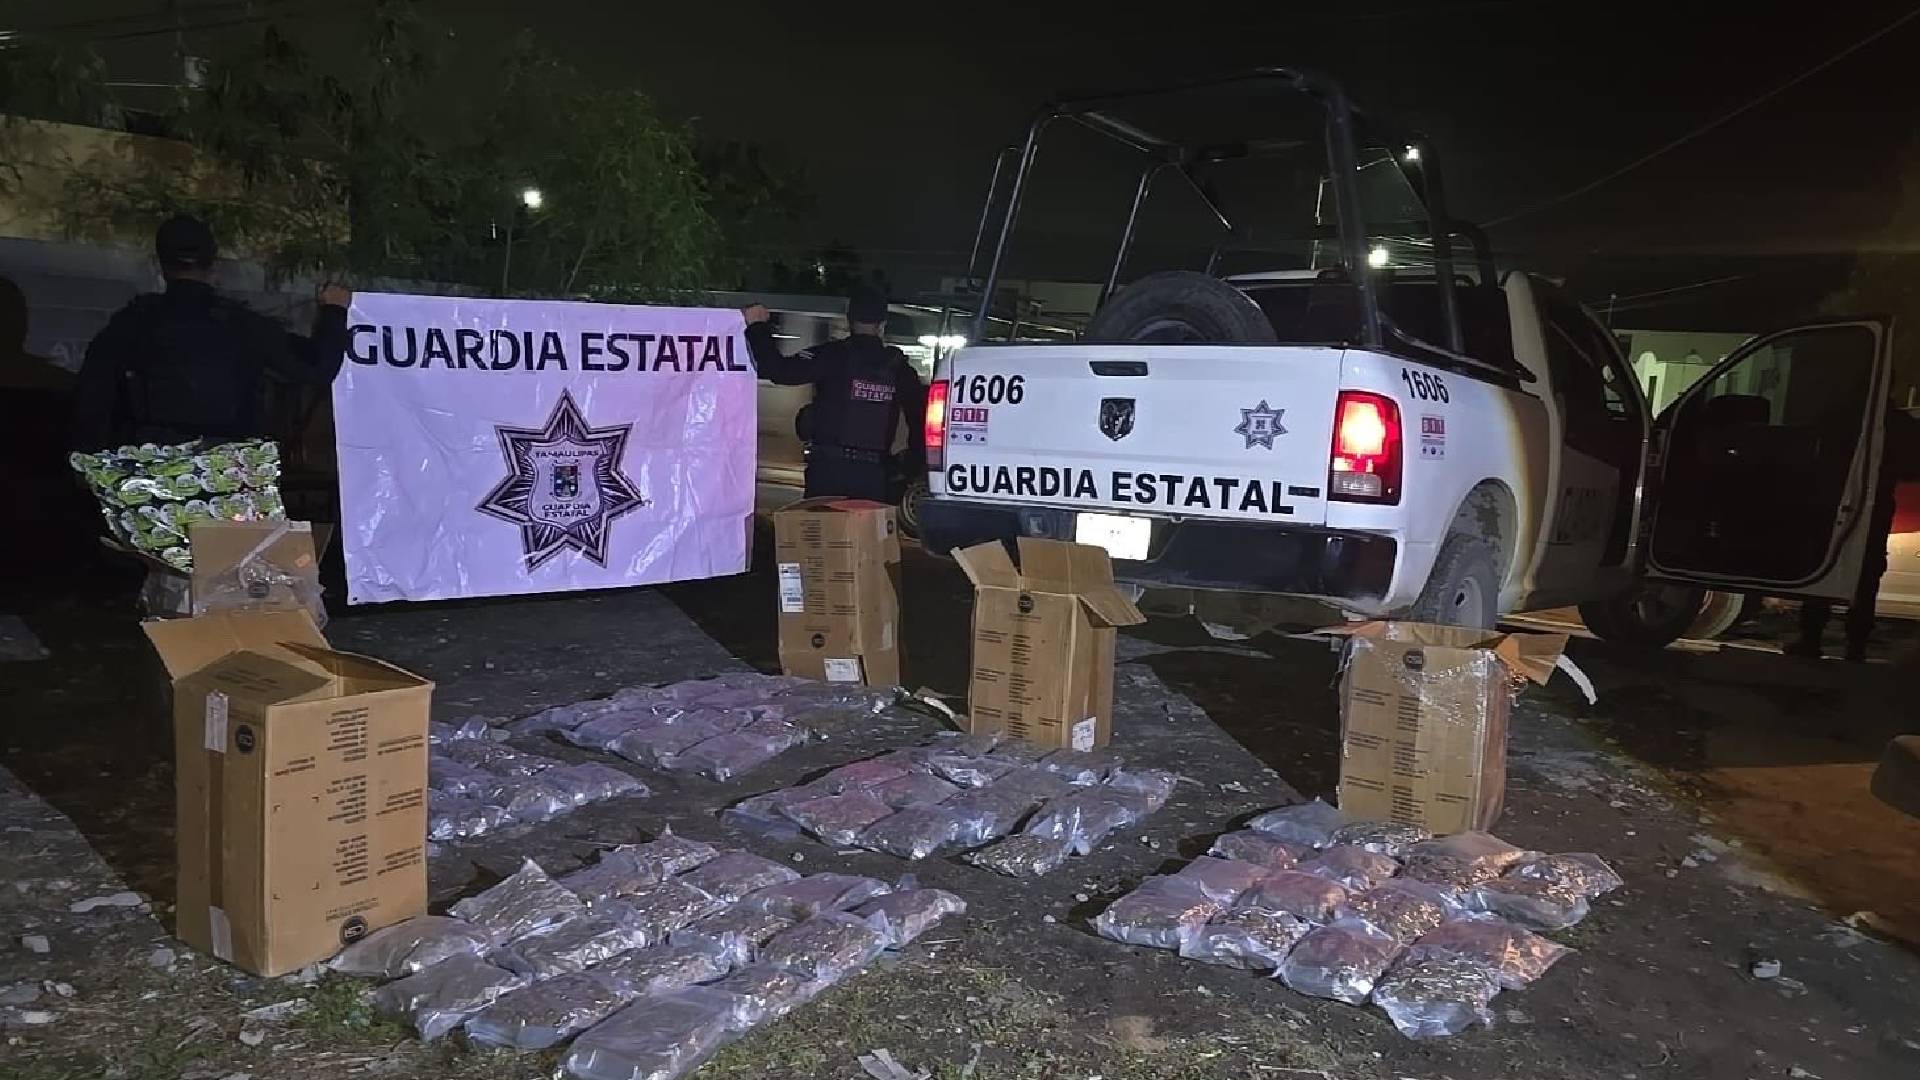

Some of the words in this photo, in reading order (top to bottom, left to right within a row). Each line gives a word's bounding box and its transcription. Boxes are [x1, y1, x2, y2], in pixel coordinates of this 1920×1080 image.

[347, 324, 568, 371] GUARDIA
[581, 332, 747, 372] ESTATAL
[953, 375, 1025, 404] 1606
[1402, 368, 1449, 404] 1606
[953, 409, 986, 421] 911
[948, 463, 1098, 500] GUARDIA
[1111, 471, 1294, 515] ESTATAL
